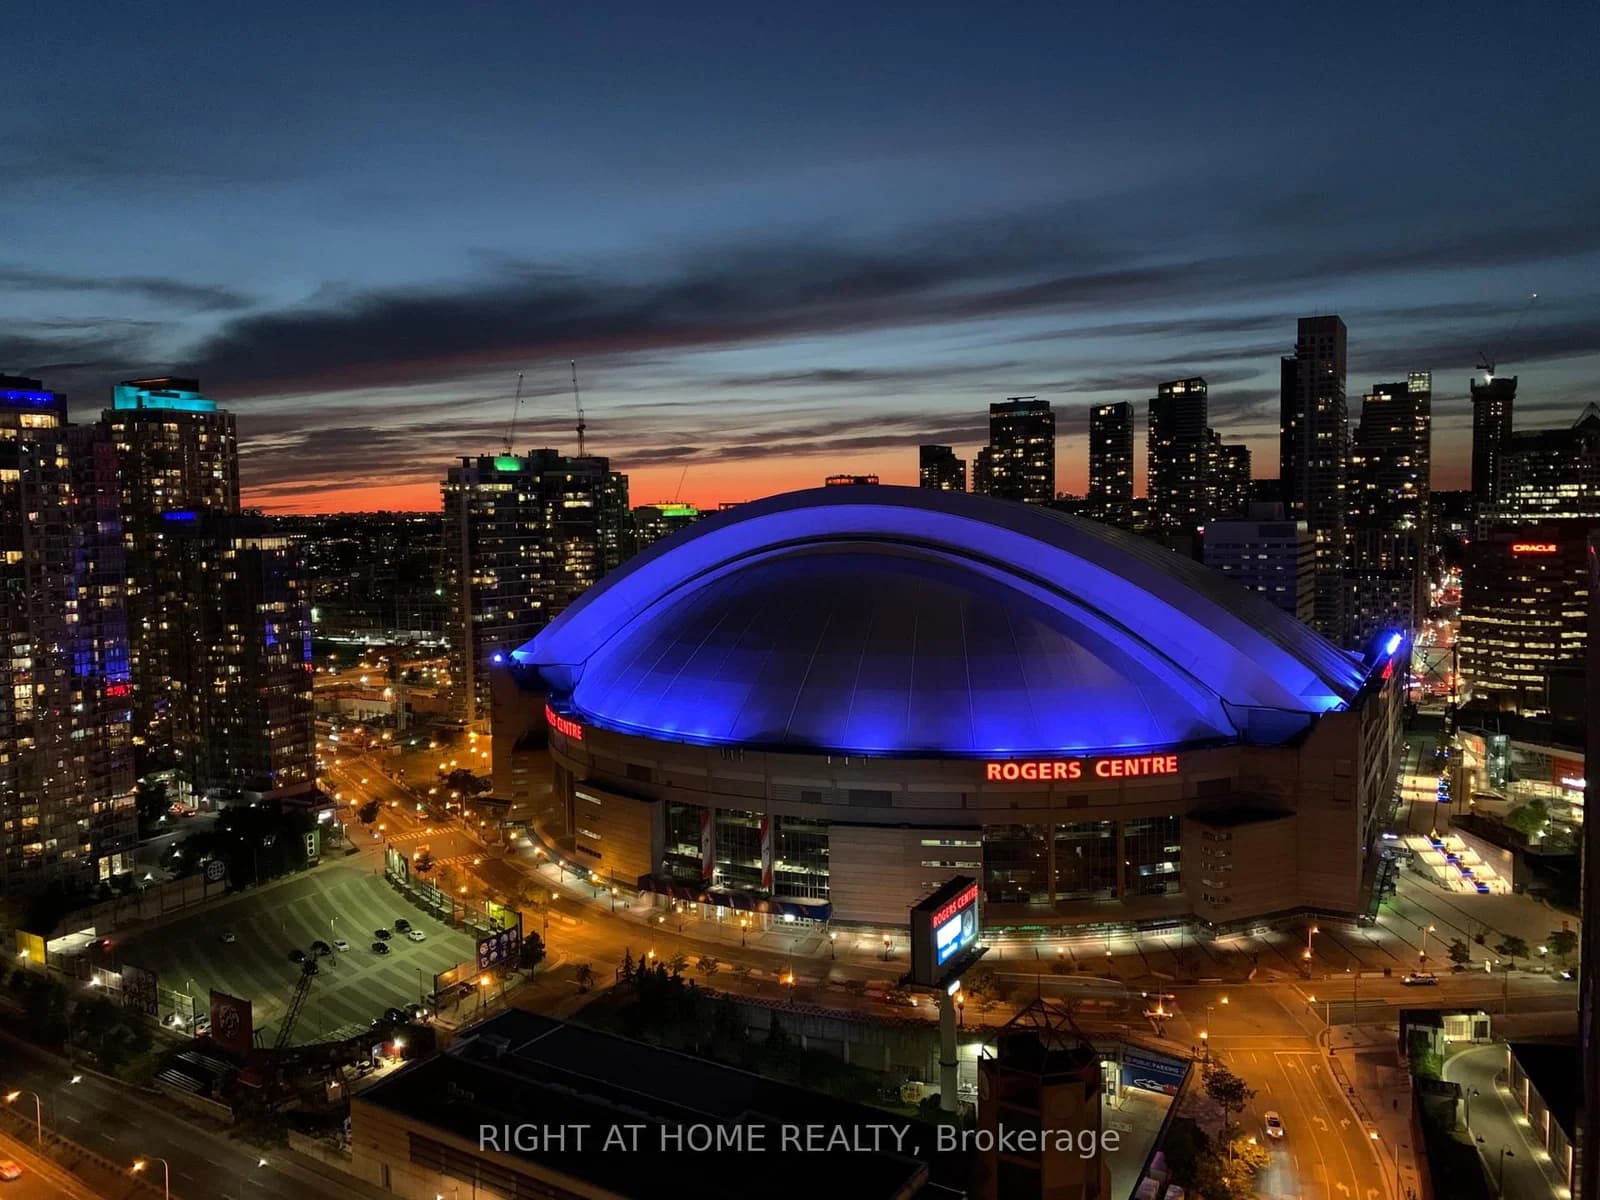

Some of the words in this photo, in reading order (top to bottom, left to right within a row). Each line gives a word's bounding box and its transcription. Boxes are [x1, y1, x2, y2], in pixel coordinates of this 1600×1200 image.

[1512, 544, 1557, 552] ORACLE
[987, 761, 1081, 780] ROGERS
[1095, 756, 1179, 777] CENTRE
[933, 902, 957, 929] ROGERS
[957, 885, 978, 908] CENTRE
